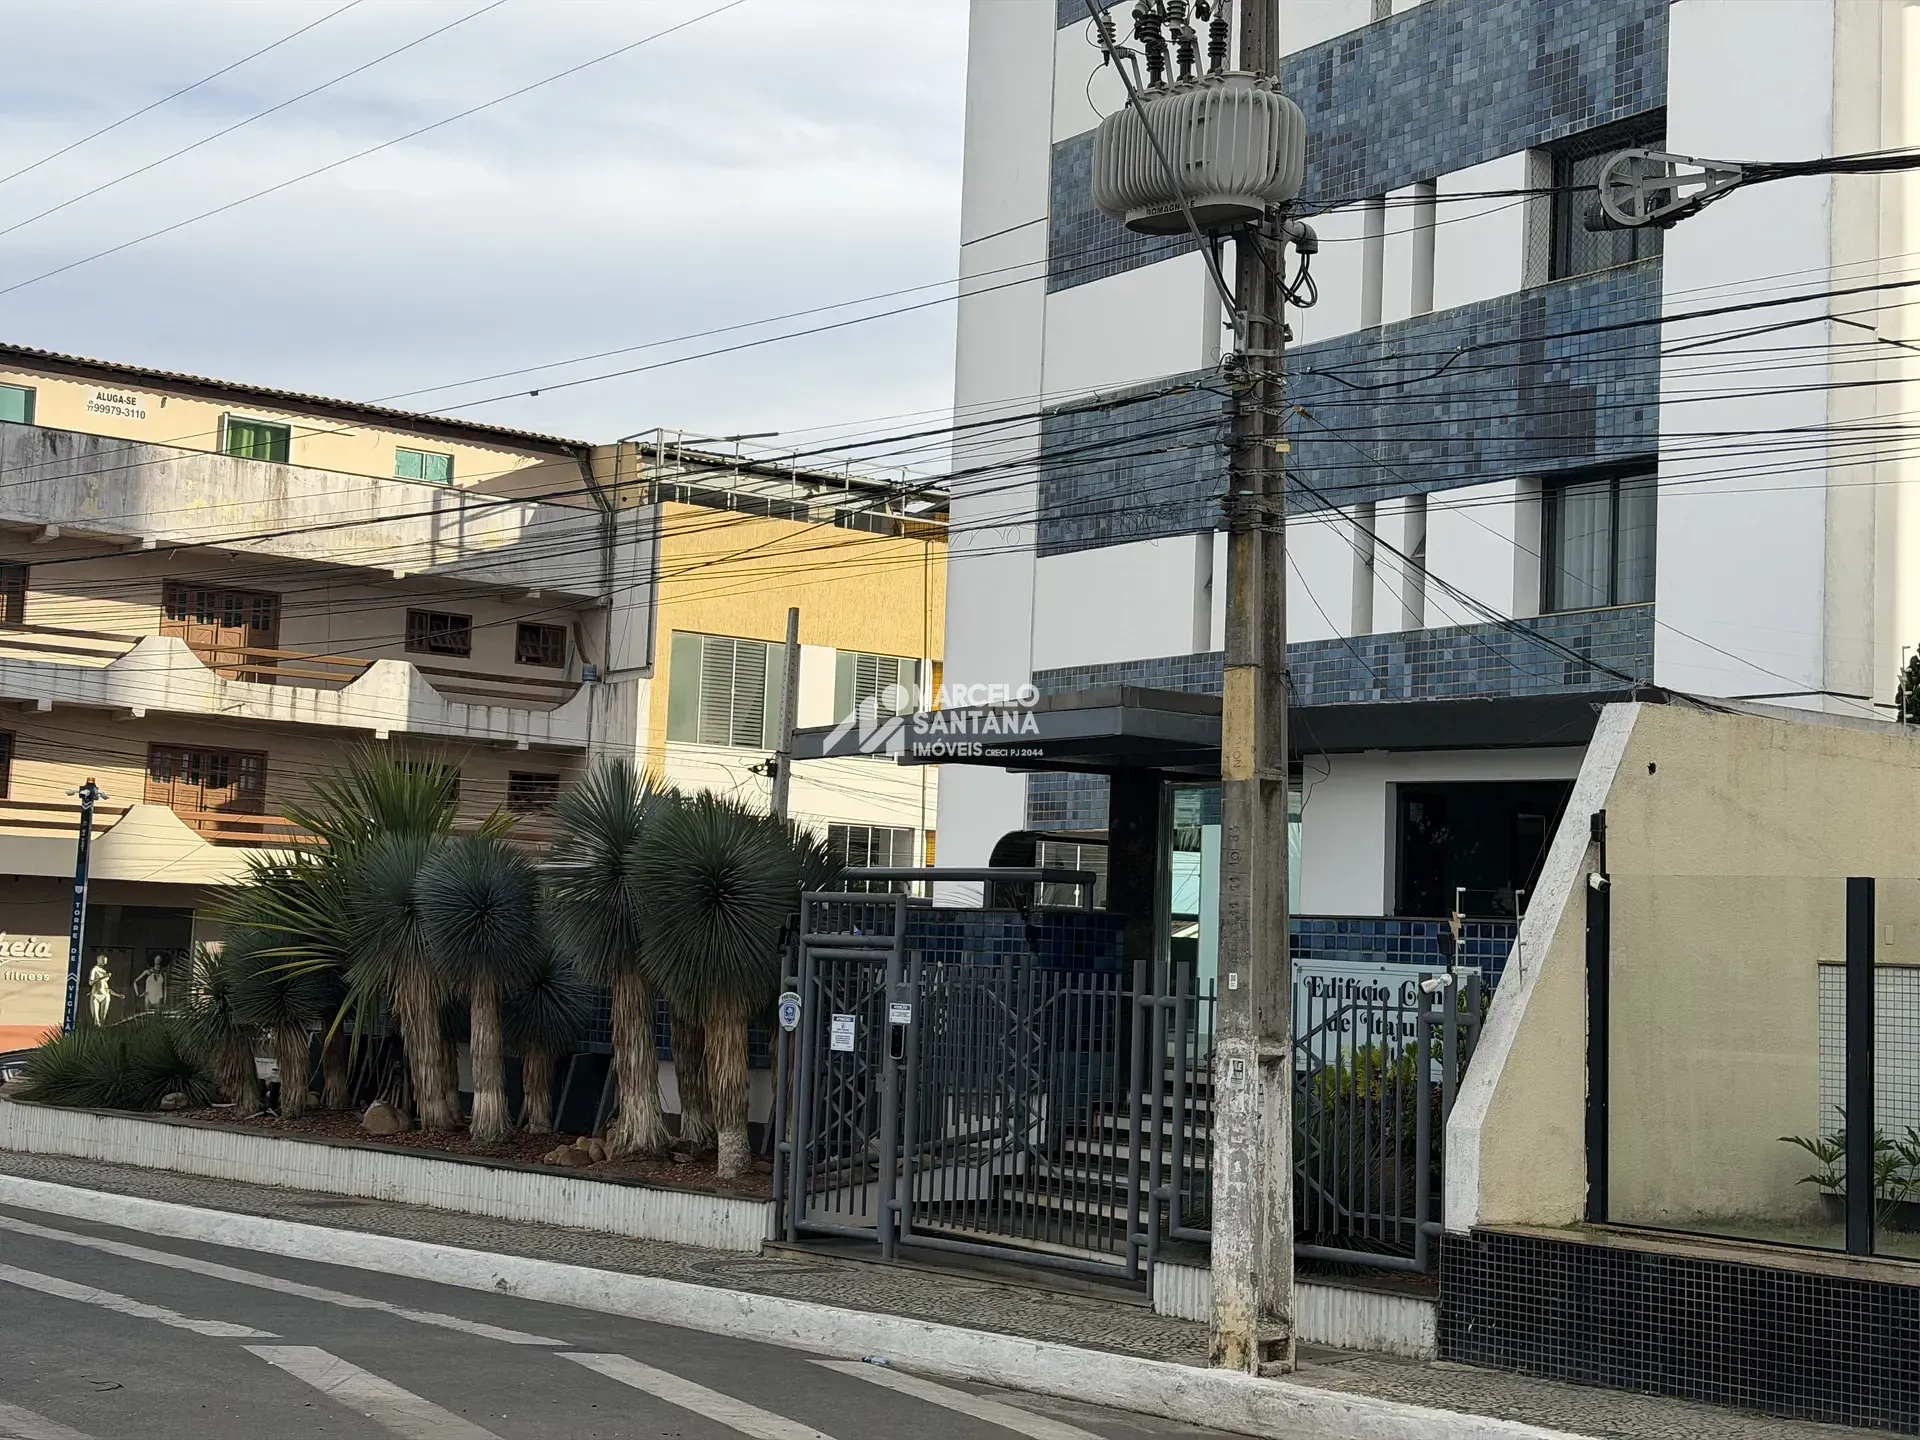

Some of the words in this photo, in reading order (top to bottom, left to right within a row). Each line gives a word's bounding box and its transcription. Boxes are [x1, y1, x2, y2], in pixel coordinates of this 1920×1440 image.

[96, 391, 137, 406] ALUGA-SE
[93, 403, 146, 420] 99979-3110
[70, 948, 77, 962] DE
[4, 971, 50, 982] fitness
